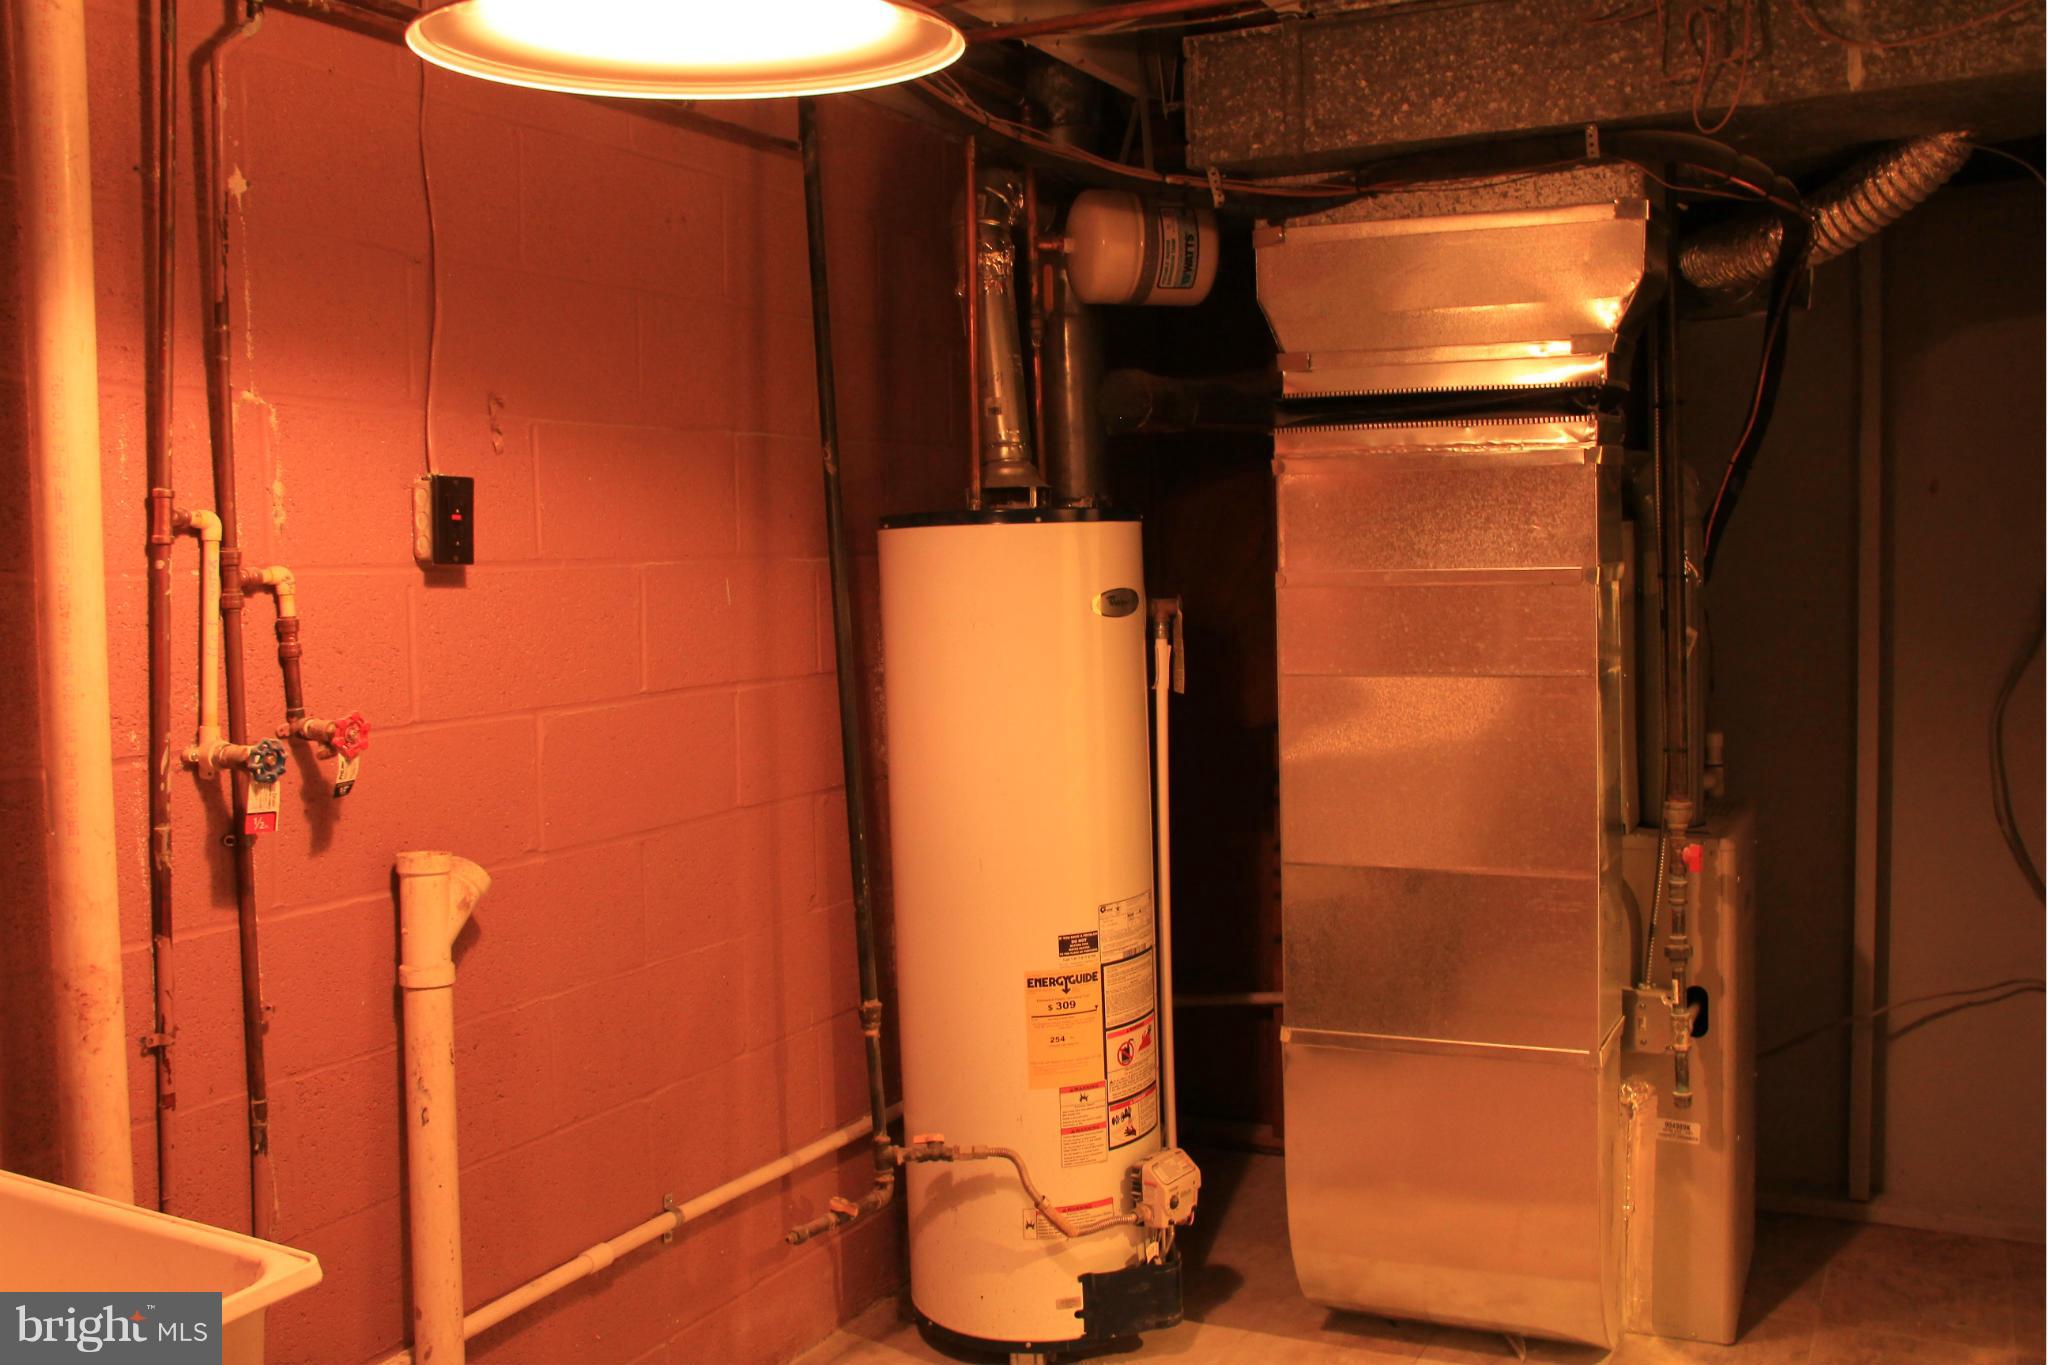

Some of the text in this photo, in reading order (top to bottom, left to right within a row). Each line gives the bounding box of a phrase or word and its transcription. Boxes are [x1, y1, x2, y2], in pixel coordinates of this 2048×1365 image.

[1183, 232, 1194, 273] WATTS
[1027, 971, 1098, 988] ENERGYGUIDE
[1056, 1000, 1076, 1010] 309
